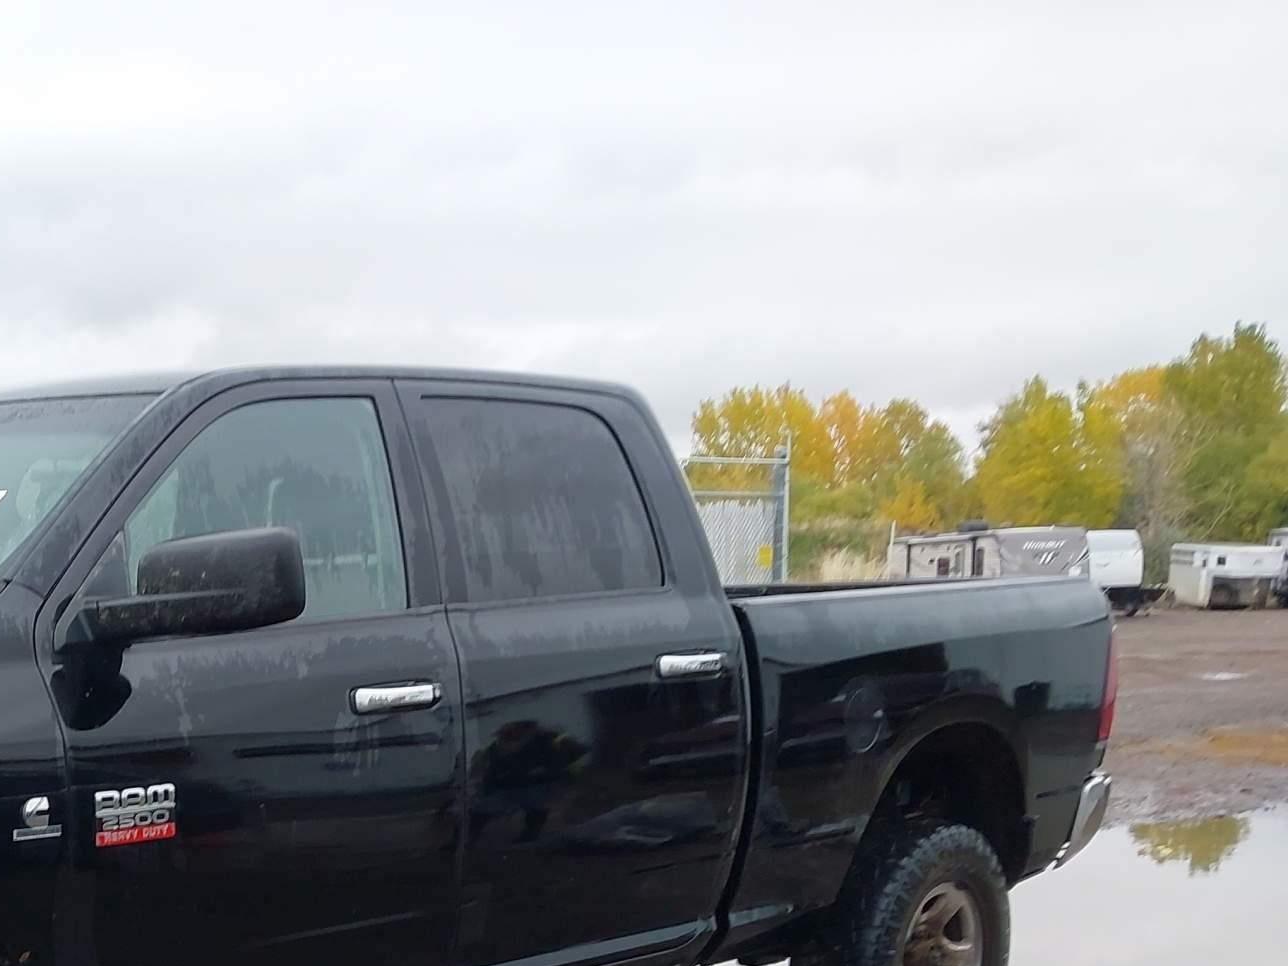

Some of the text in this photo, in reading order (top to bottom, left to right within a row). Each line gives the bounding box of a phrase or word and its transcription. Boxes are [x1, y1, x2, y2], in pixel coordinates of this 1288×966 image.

[94, 783, 176, 815] RAM
[102, 809, 170, 831] 2500
[103, 824, 171, 844] HEAVY DUTY
